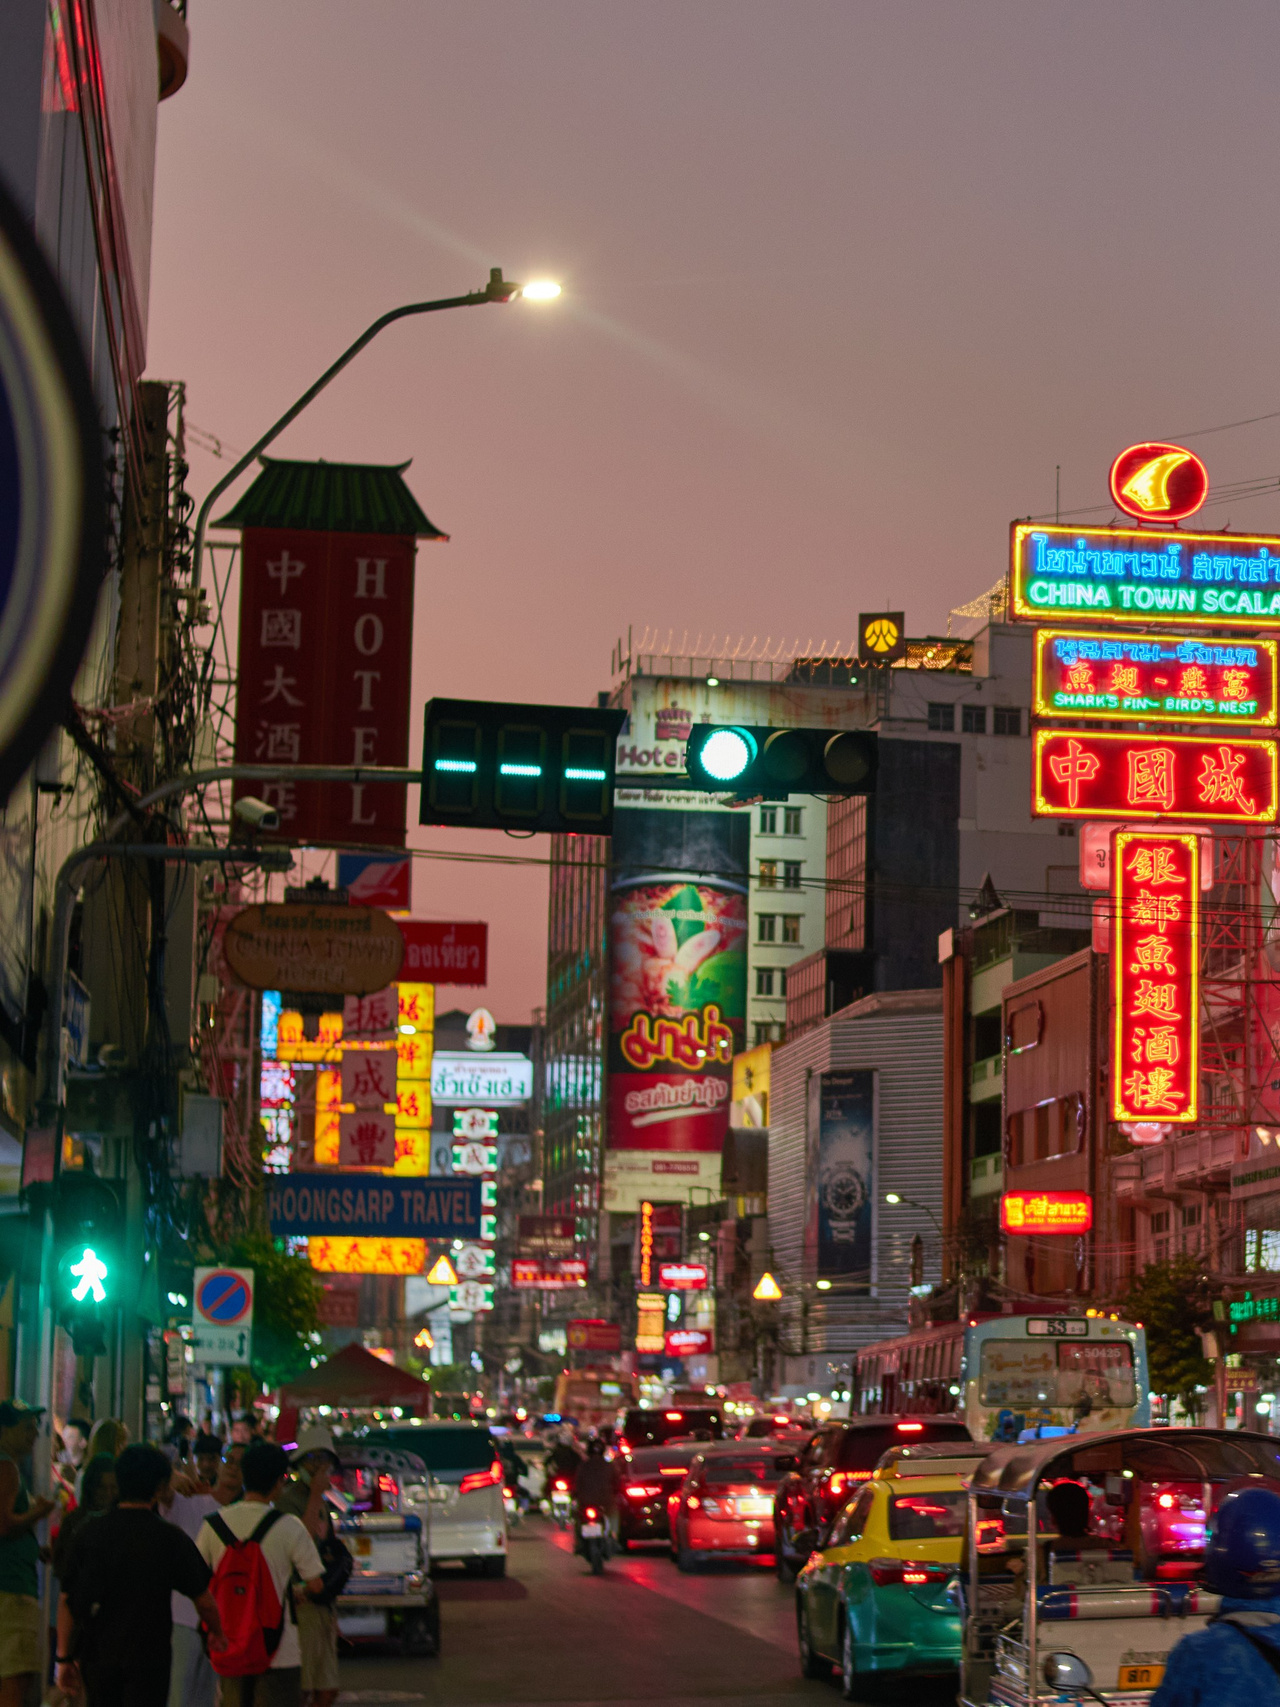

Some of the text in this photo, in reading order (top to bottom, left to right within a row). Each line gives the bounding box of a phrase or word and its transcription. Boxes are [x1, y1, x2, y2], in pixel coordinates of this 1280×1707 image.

[1031, 533, 1182, 579] ไชน่าทาวน์
[1030, 581, 1112, 607] CHINA
[1118, 586, 1197, 611] TOWN
[350, 558, 388, 825] HOTEL
[1054, 692, 1118, 708] SHARK'S
[1166, 698, 1216, 712] BIRD'S
[1219, 701, 1257, 715] NEST
[1050, 740, 1256, 815] 中國城
[1125, 847, 1185, 1111] 銀都魚翅酒樓
[625, 1076, 729, 1114] รสต้มยำกุ้ง
[401, 1189, 475, 1224] TRAVEL
[1047, 1320, 1067, 1334] 53
